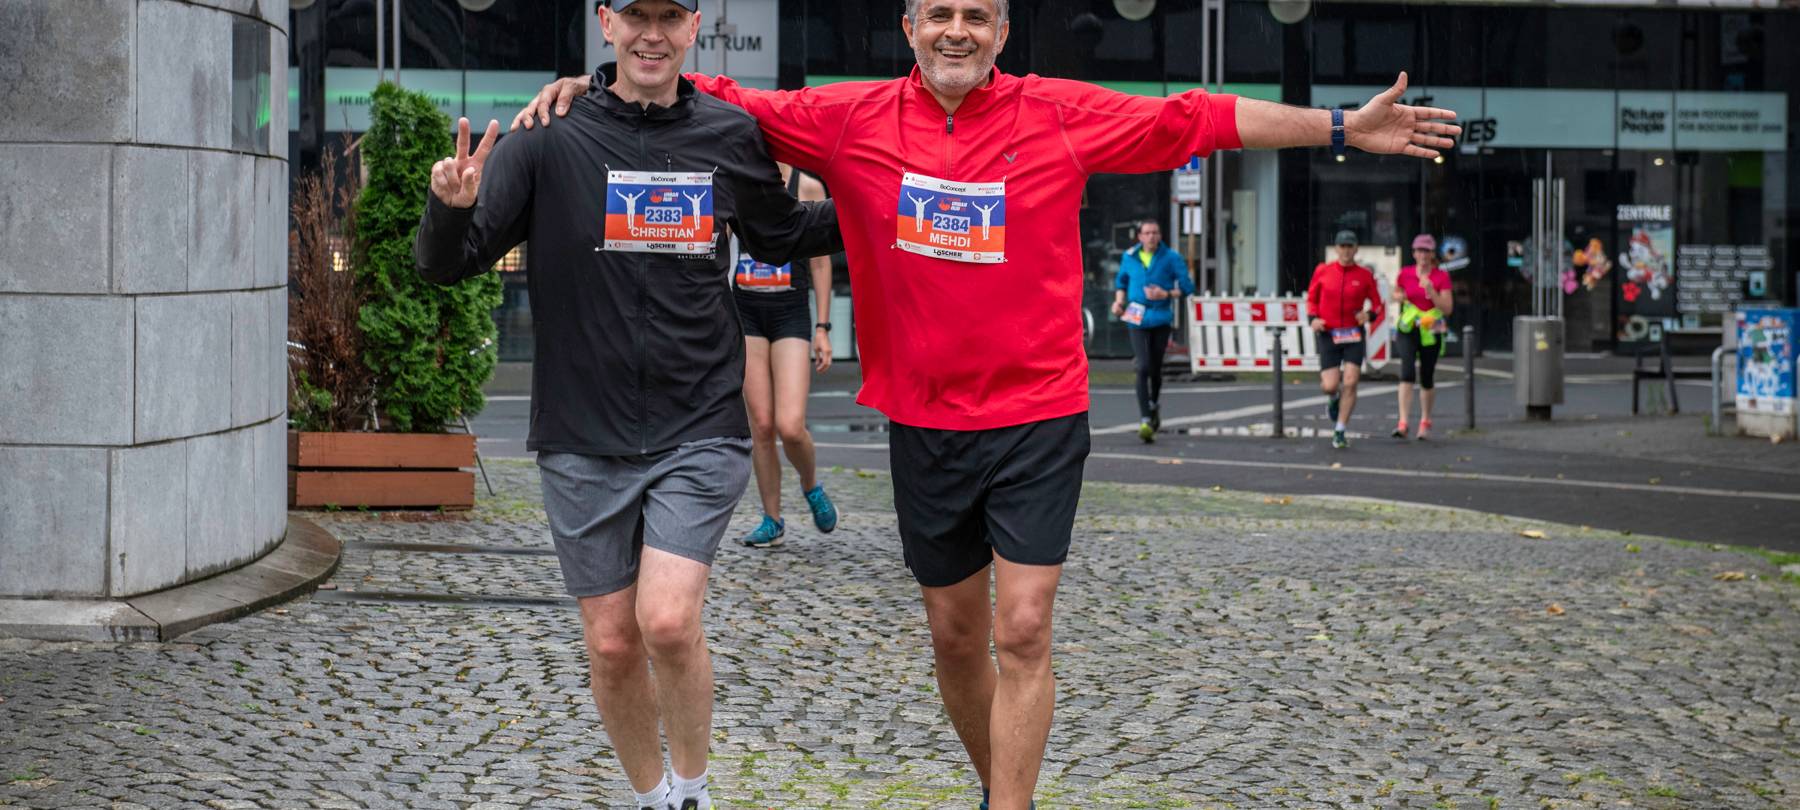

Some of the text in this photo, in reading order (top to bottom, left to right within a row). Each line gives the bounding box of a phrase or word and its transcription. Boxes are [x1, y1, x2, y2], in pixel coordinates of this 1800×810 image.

[1621, 107, 1666, 119] Picture
[1621, 119, 1665, 134] People
[939, 183, 967, 193] BoConcept
[645, 209, 681, 223] 2383
[1617, 205, 1672, 221] ZENTRALE
[933, 215, 969, 232] 2384
[631, 227, 695, 239] CHRISTIAN
[929, 232, 971, 248] MEHDI
